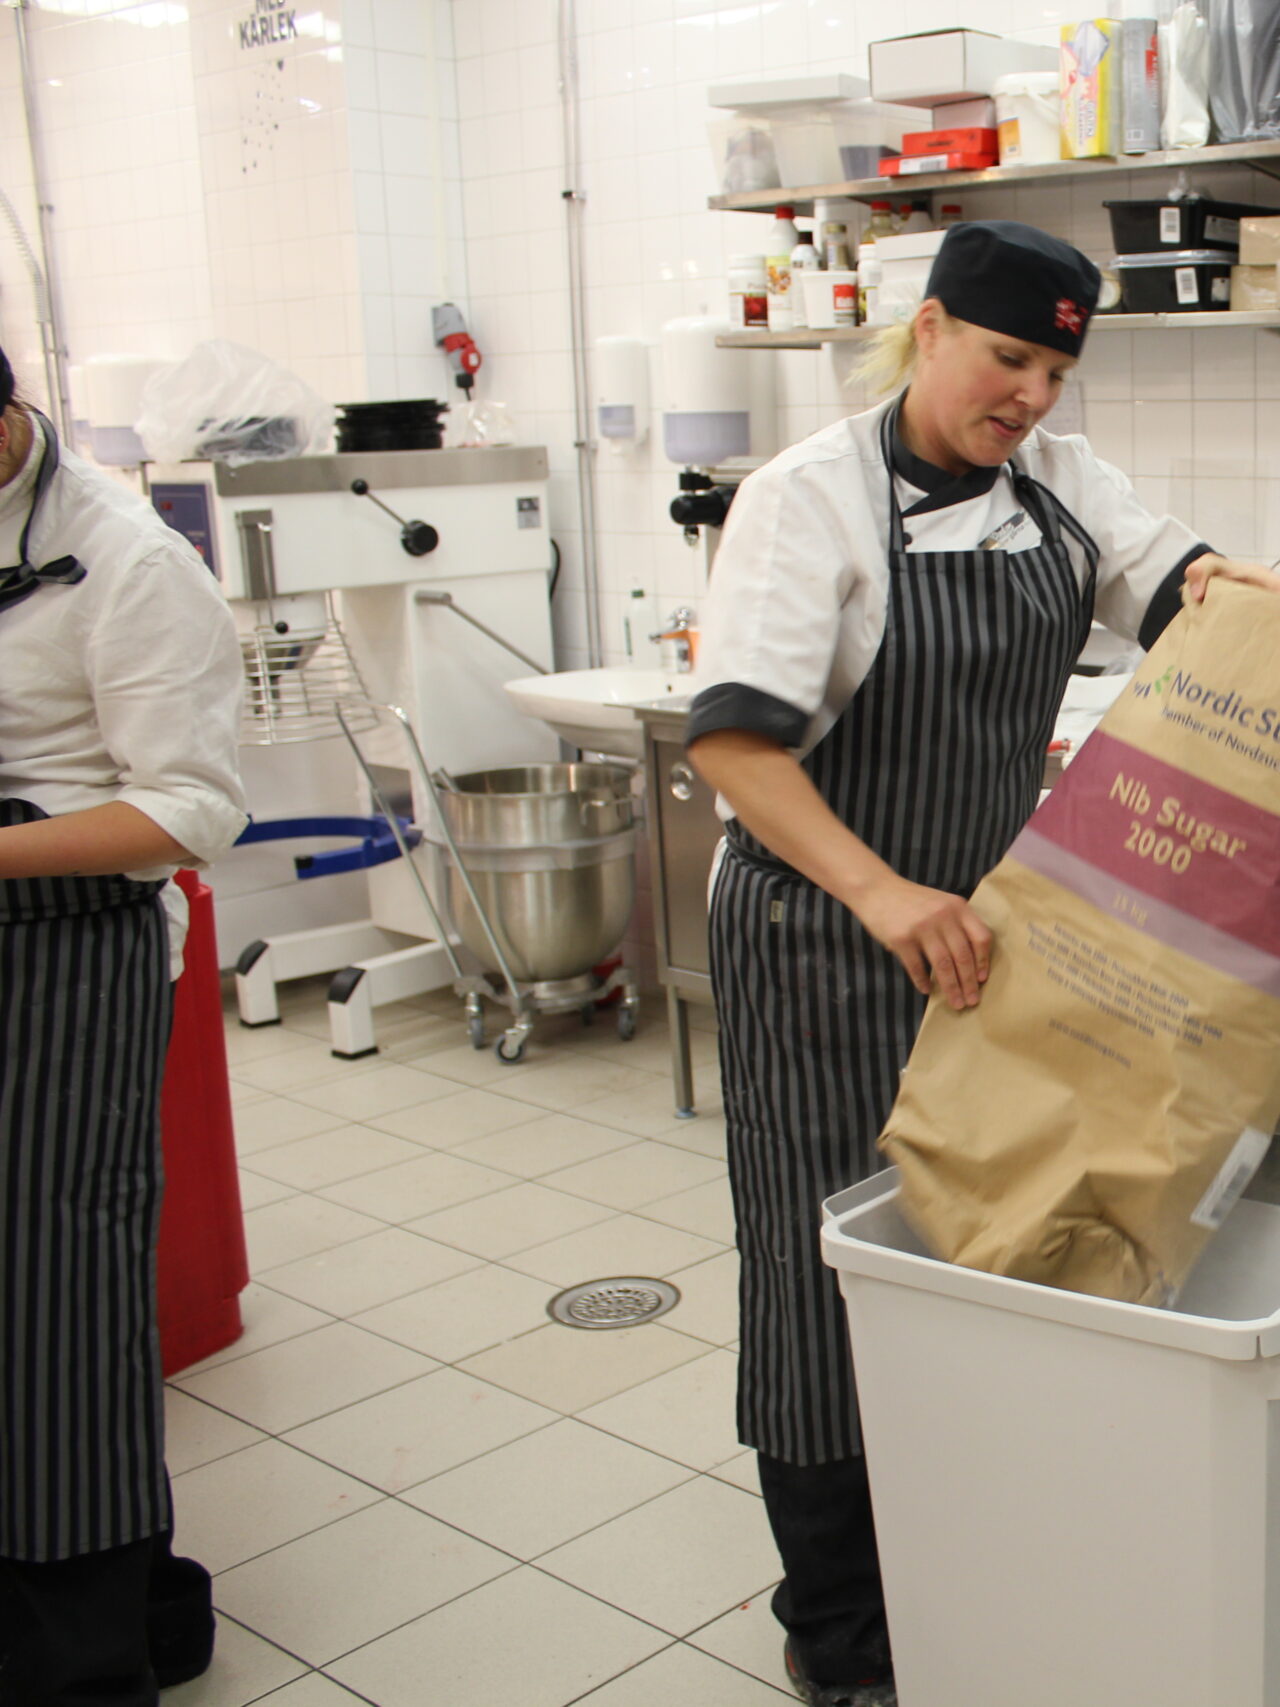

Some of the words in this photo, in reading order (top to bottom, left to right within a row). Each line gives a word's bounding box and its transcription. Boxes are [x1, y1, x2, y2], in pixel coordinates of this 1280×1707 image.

[239, 9, 298, 50] KÄRLEK
[1170, 669, 1255, 728] Nordic
[1208, 727, 1226, 744] of
[1109, 771, 1151, 816] Nib
[1156, 796, 1248, 859] Sugar
[1124, 820, 1193, 875] 2000
